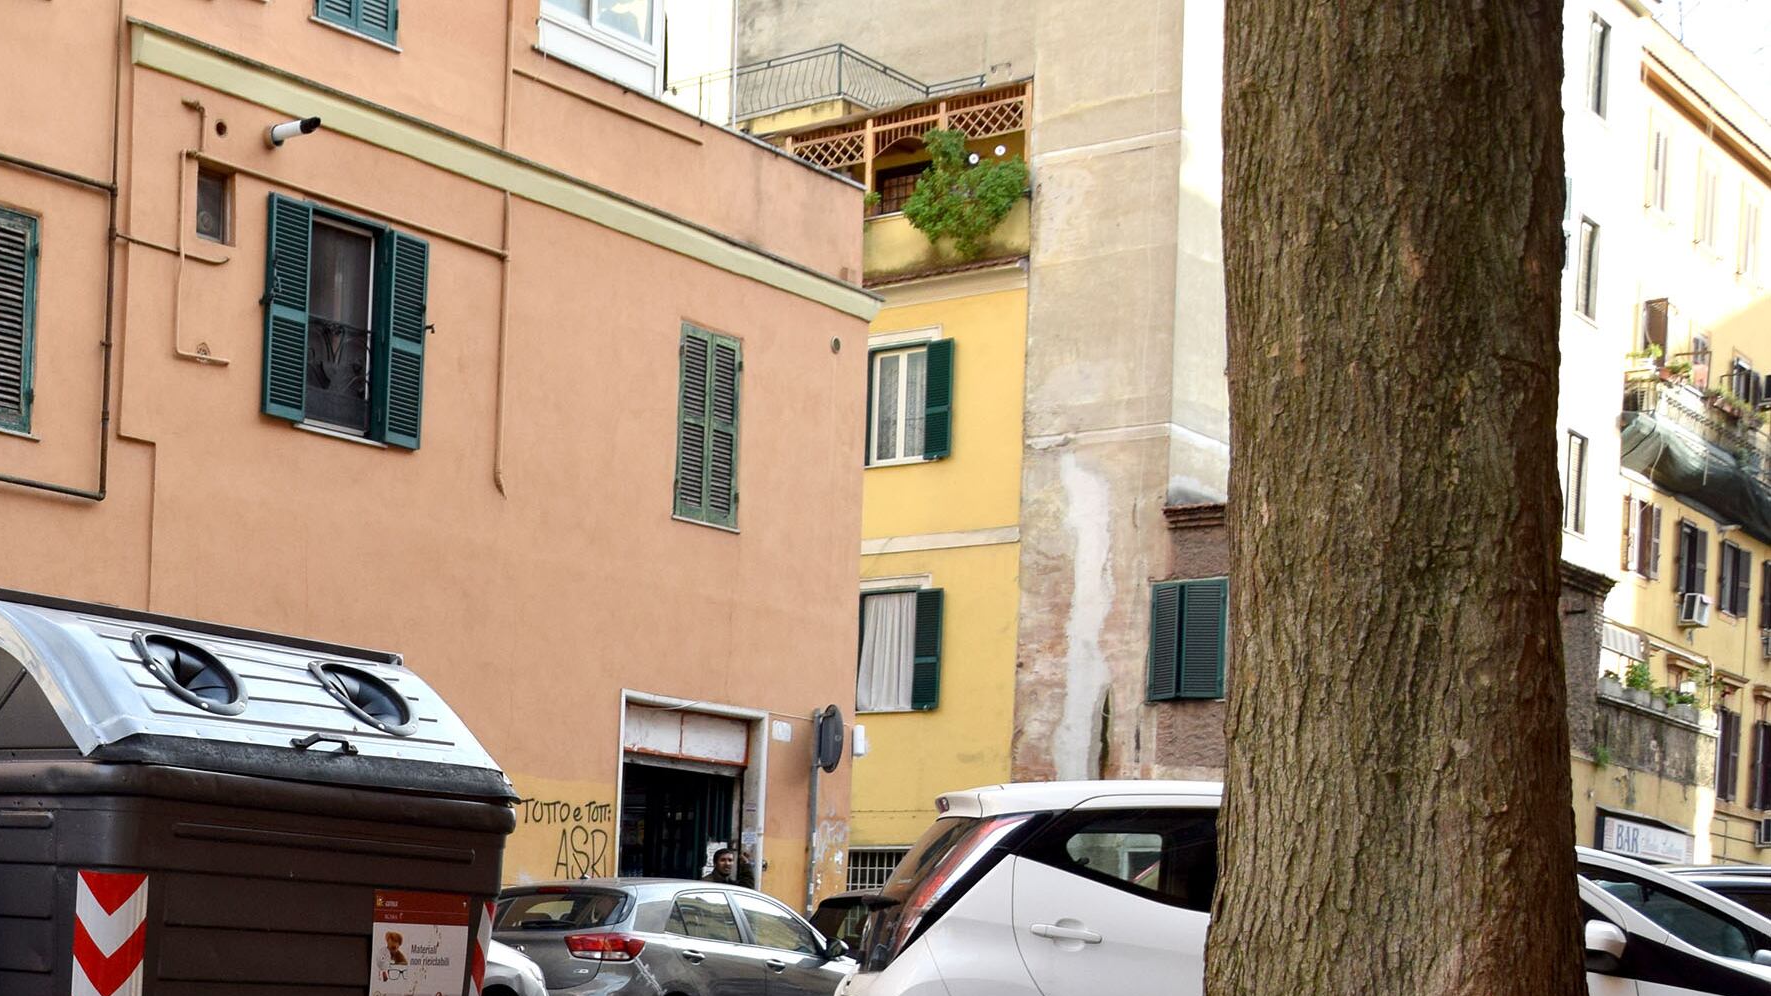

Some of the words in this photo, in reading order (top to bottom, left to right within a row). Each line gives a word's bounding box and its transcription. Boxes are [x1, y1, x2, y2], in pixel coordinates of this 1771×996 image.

[573, 807, 583, 821] e
[1616, 823, 1640, 853] BAR
[411, 944, 437, 955] Materiali
[410, 957, 423, 966] non
